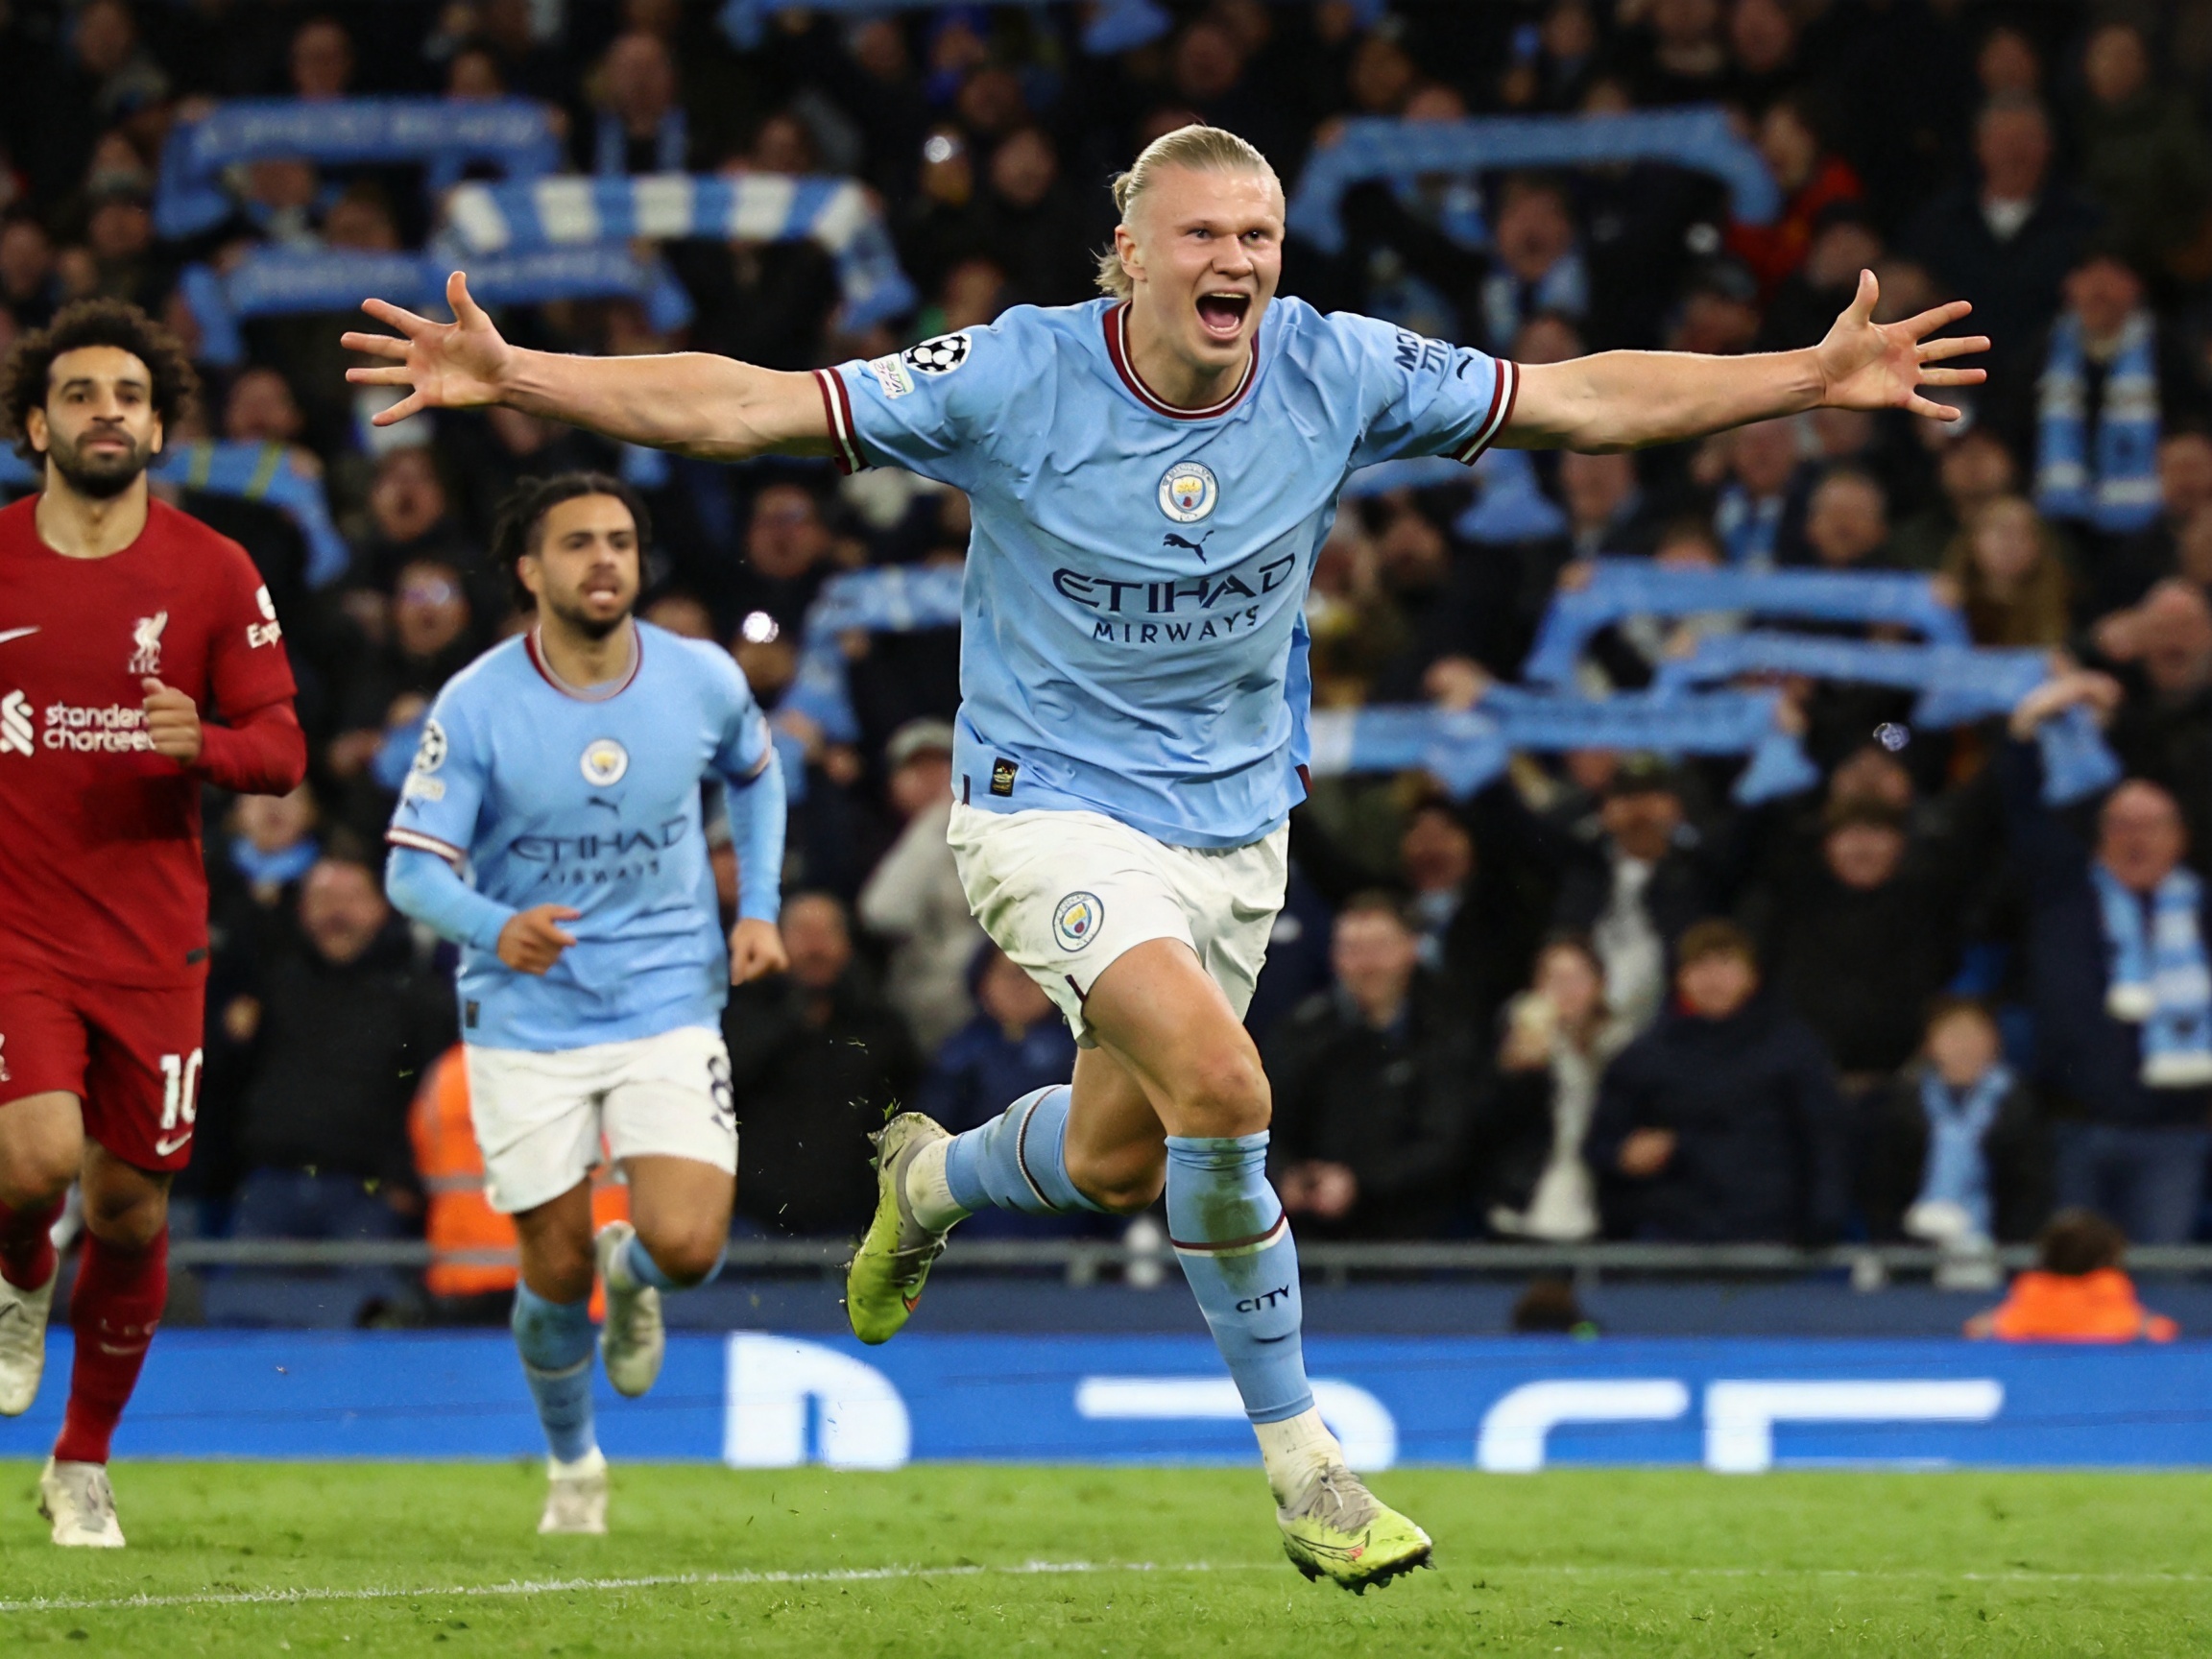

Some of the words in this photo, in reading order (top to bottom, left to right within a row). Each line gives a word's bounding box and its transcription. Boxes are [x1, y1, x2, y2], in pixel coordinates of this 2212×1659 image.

[1052, 553, 1295, 613] ETIHAD
[510, 814, 687, 863] ETIHAD
[1236, 1285, 1289, 1313] CITY
